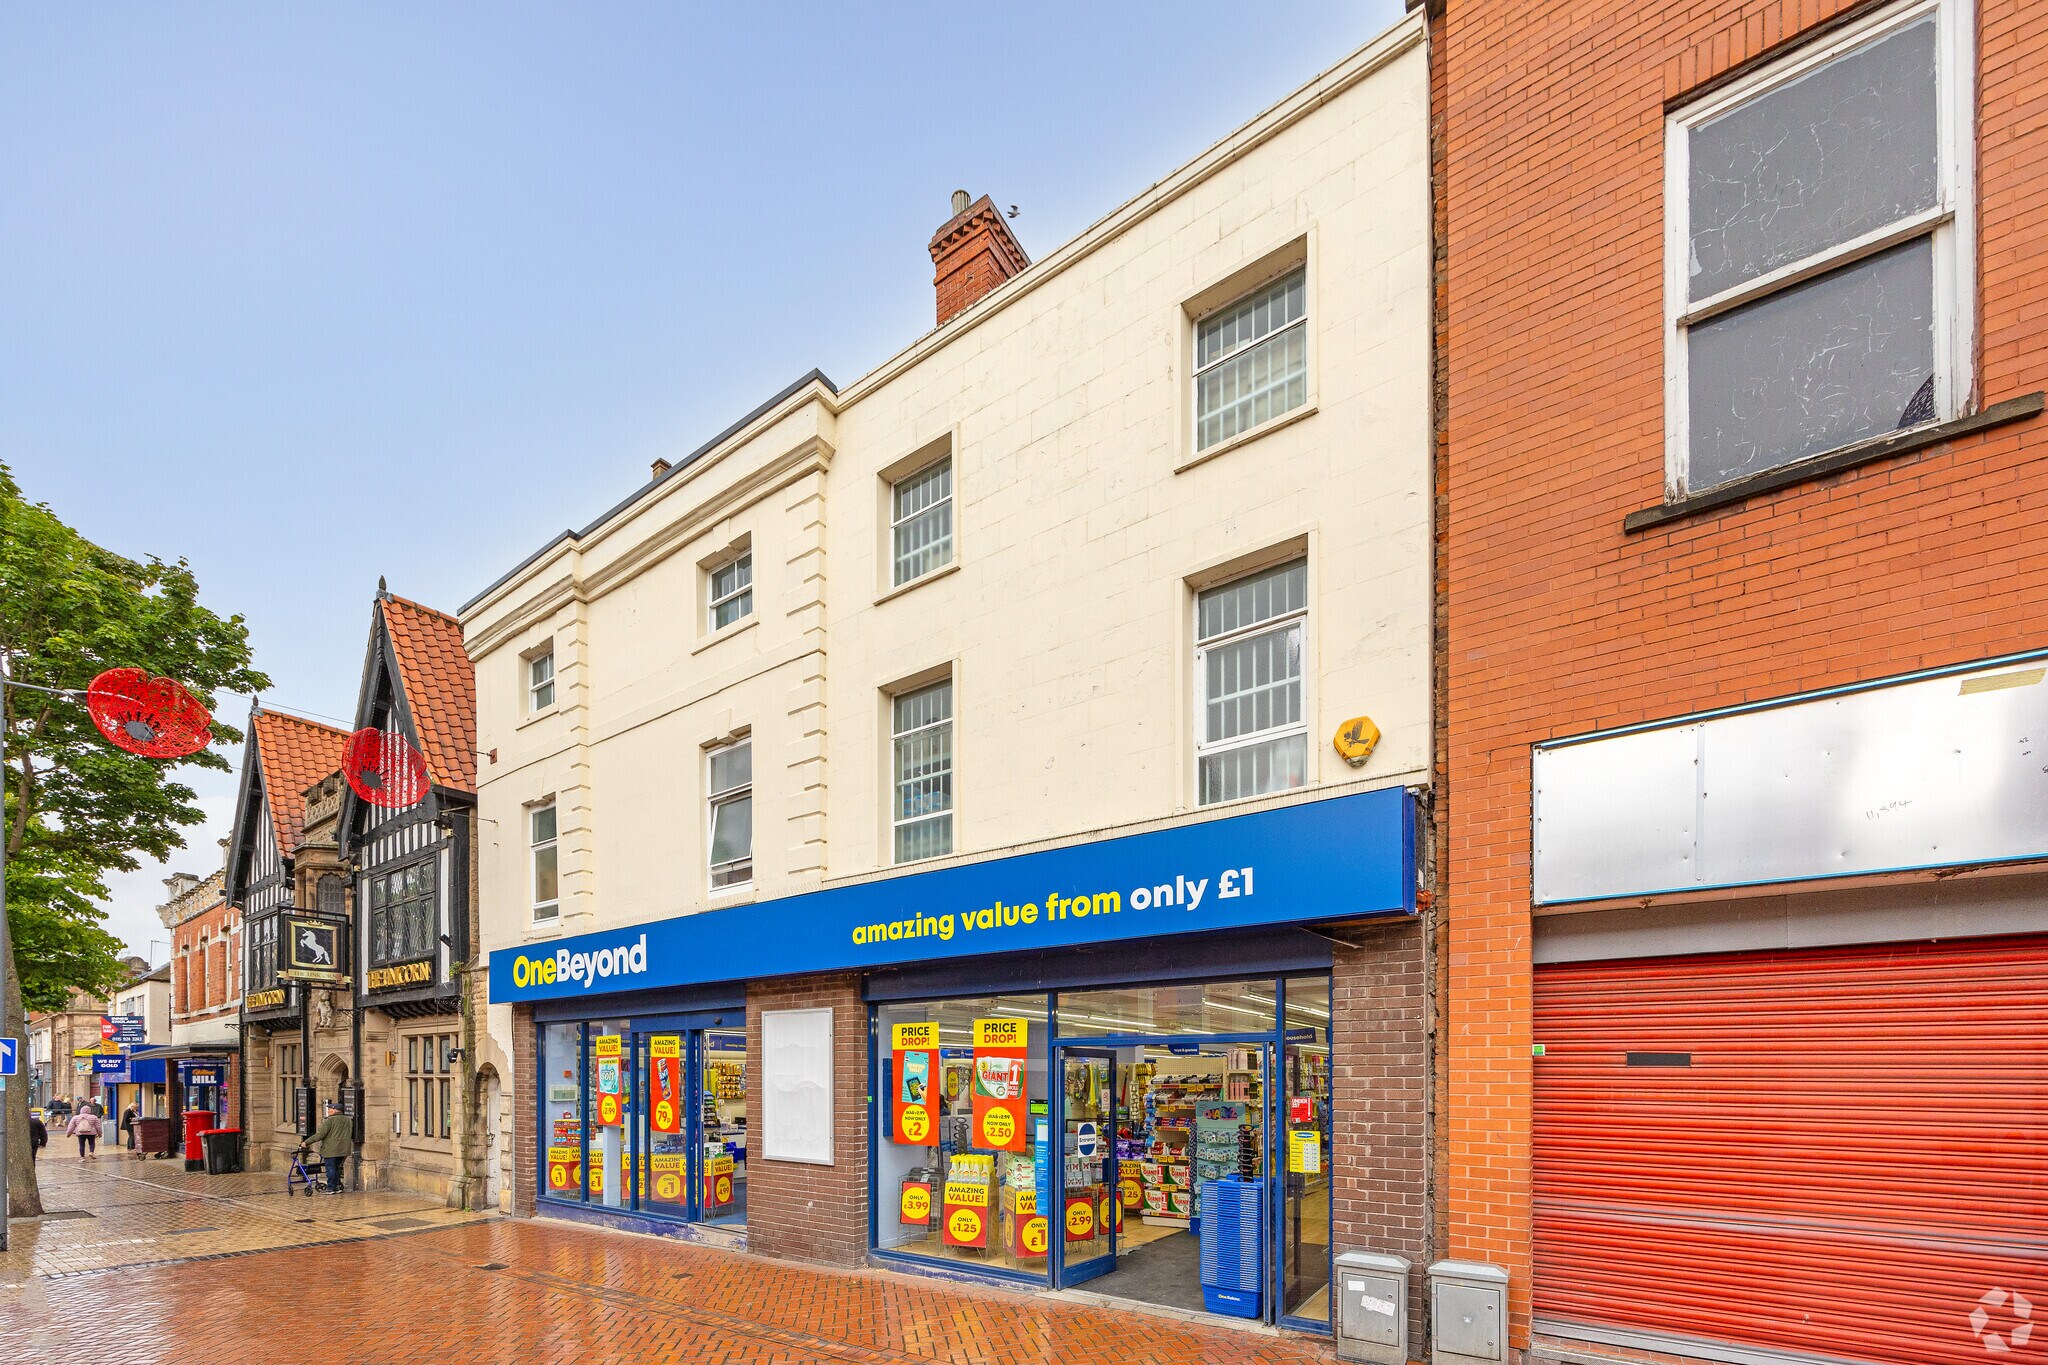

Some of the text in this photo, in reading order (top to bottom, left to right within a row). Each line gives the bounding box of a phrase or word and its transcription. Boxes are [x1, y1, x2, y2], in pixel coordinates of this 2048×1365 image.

[851, 867, 1254, 945] amazing value from only £1
[513, 934, 647, 988] OneBeyond
[901, 1026, 930, 1036] PRICE
[984, 1023, 1017, 1033] PRICE
[901, 1037, 930, 1046] DROP!
[984, 1034, 1017, 1044] DROP!
[192, 1075, 217, 1084] HILL
[982, 1071, 1008, 1081] GIANT
[1010, 1064, 1019, 1085] 1
[657, 1110, 671, 1123] 79p
[908, 1122, 922, 1136] £2
[986, 1127, 1012, 1138] £2.50
[555, 1172, 563, 1182] £1
[591, 1176, 601, 1187] £1
[663, 1182, 675, 1194] £1
[948, 1186, 984, 1195] AMAZING
[948, 1192, 984, 1203] VALUE!
[904, 1201, 928, 1210] £3.99
[1068, 1216, 1092, 1227] £2.99
[953, 1222, 977, 1233] £1.25
